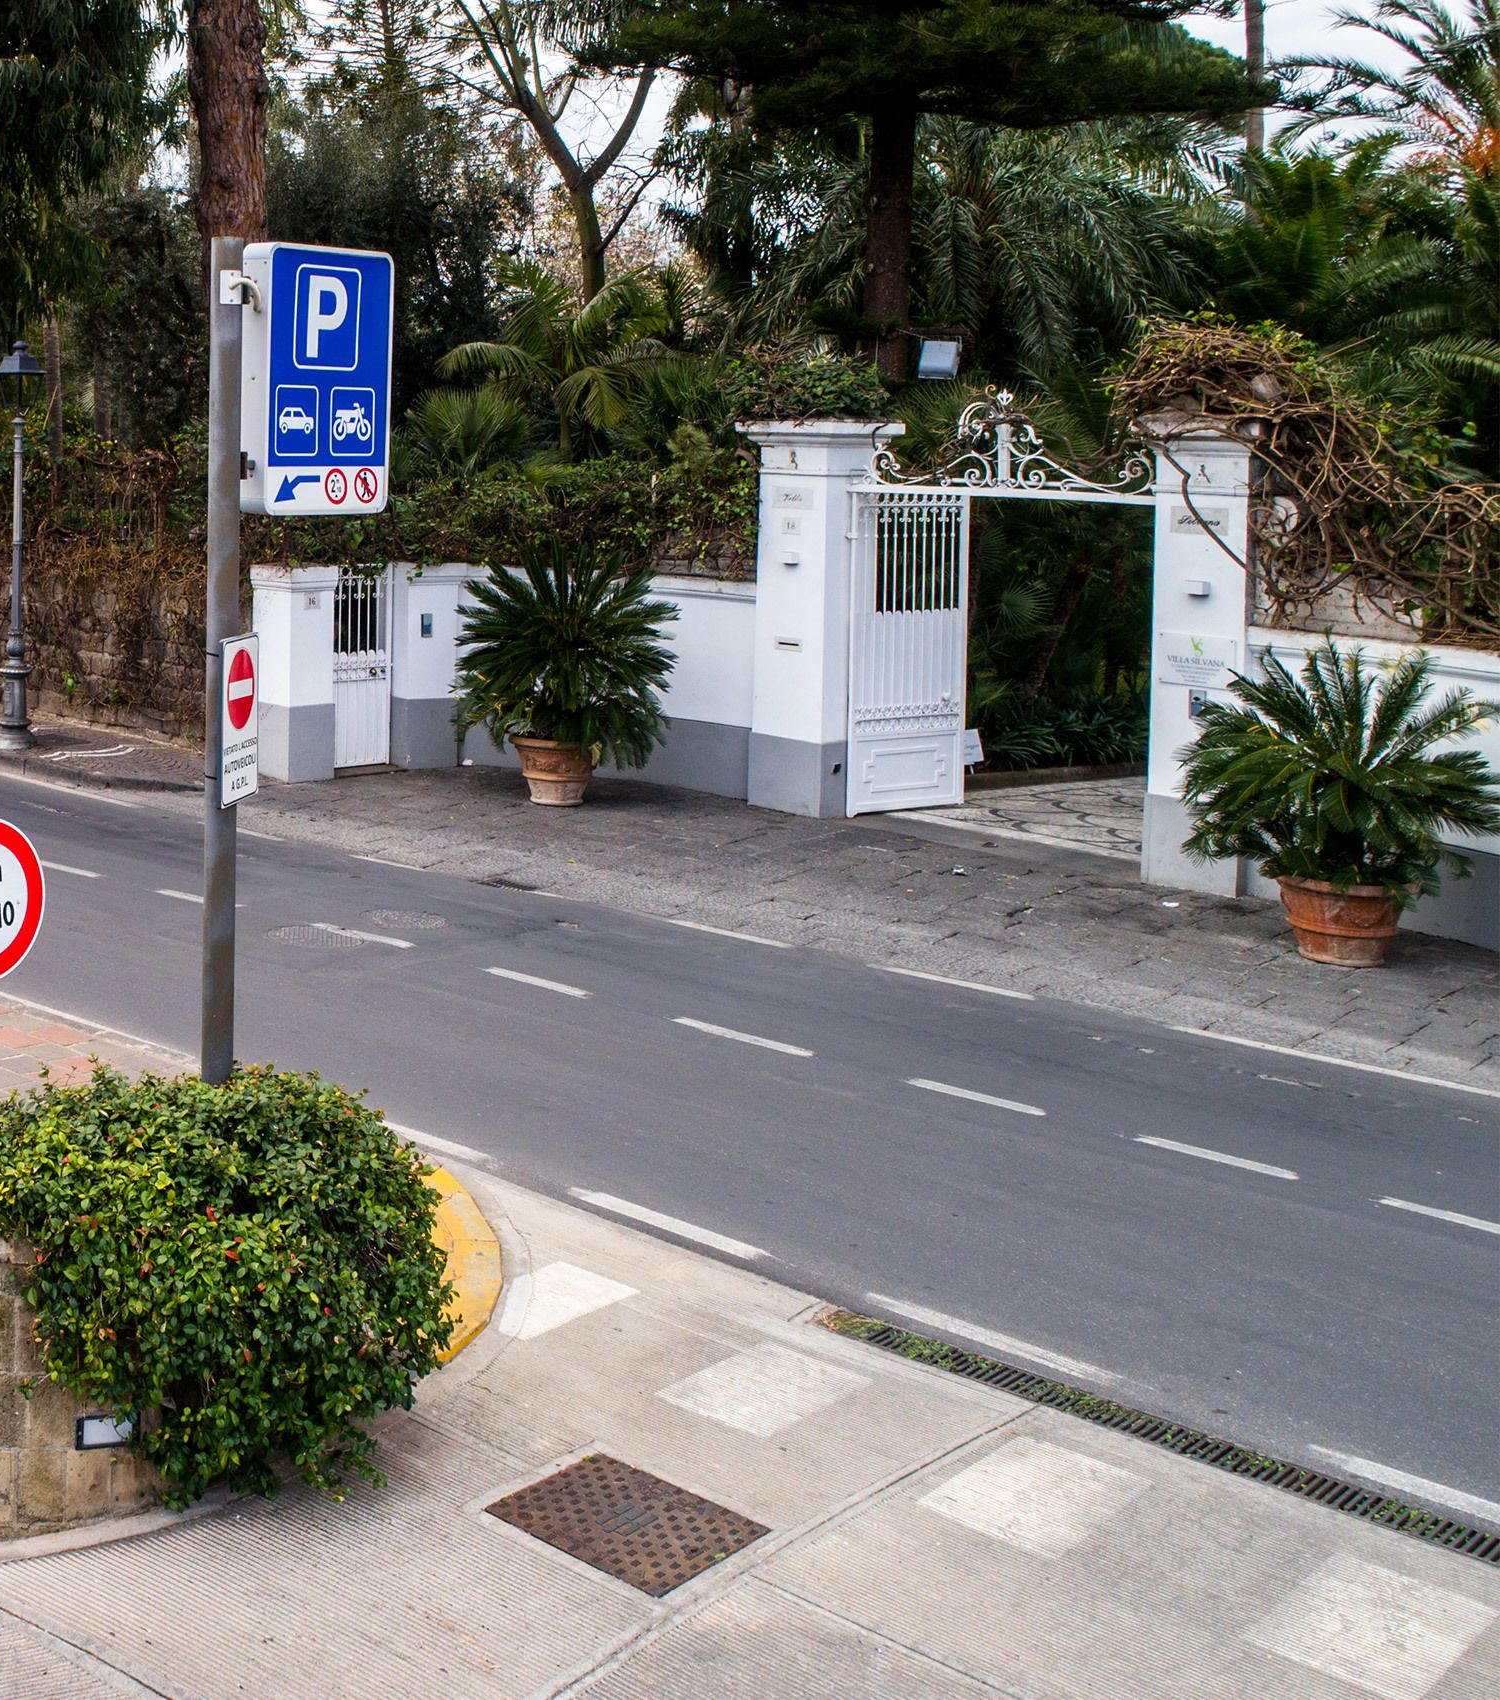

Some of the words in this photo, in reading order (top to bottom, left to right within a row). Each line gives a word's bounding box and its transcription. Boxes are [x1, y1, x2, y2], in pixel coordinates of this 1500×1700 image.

[306, 274, 348, 359] P
[1167, 655, 1190, 664] VILLA
[1190, 658, 1225, 667] SILVANA
[231, 780, 235, 791] A
